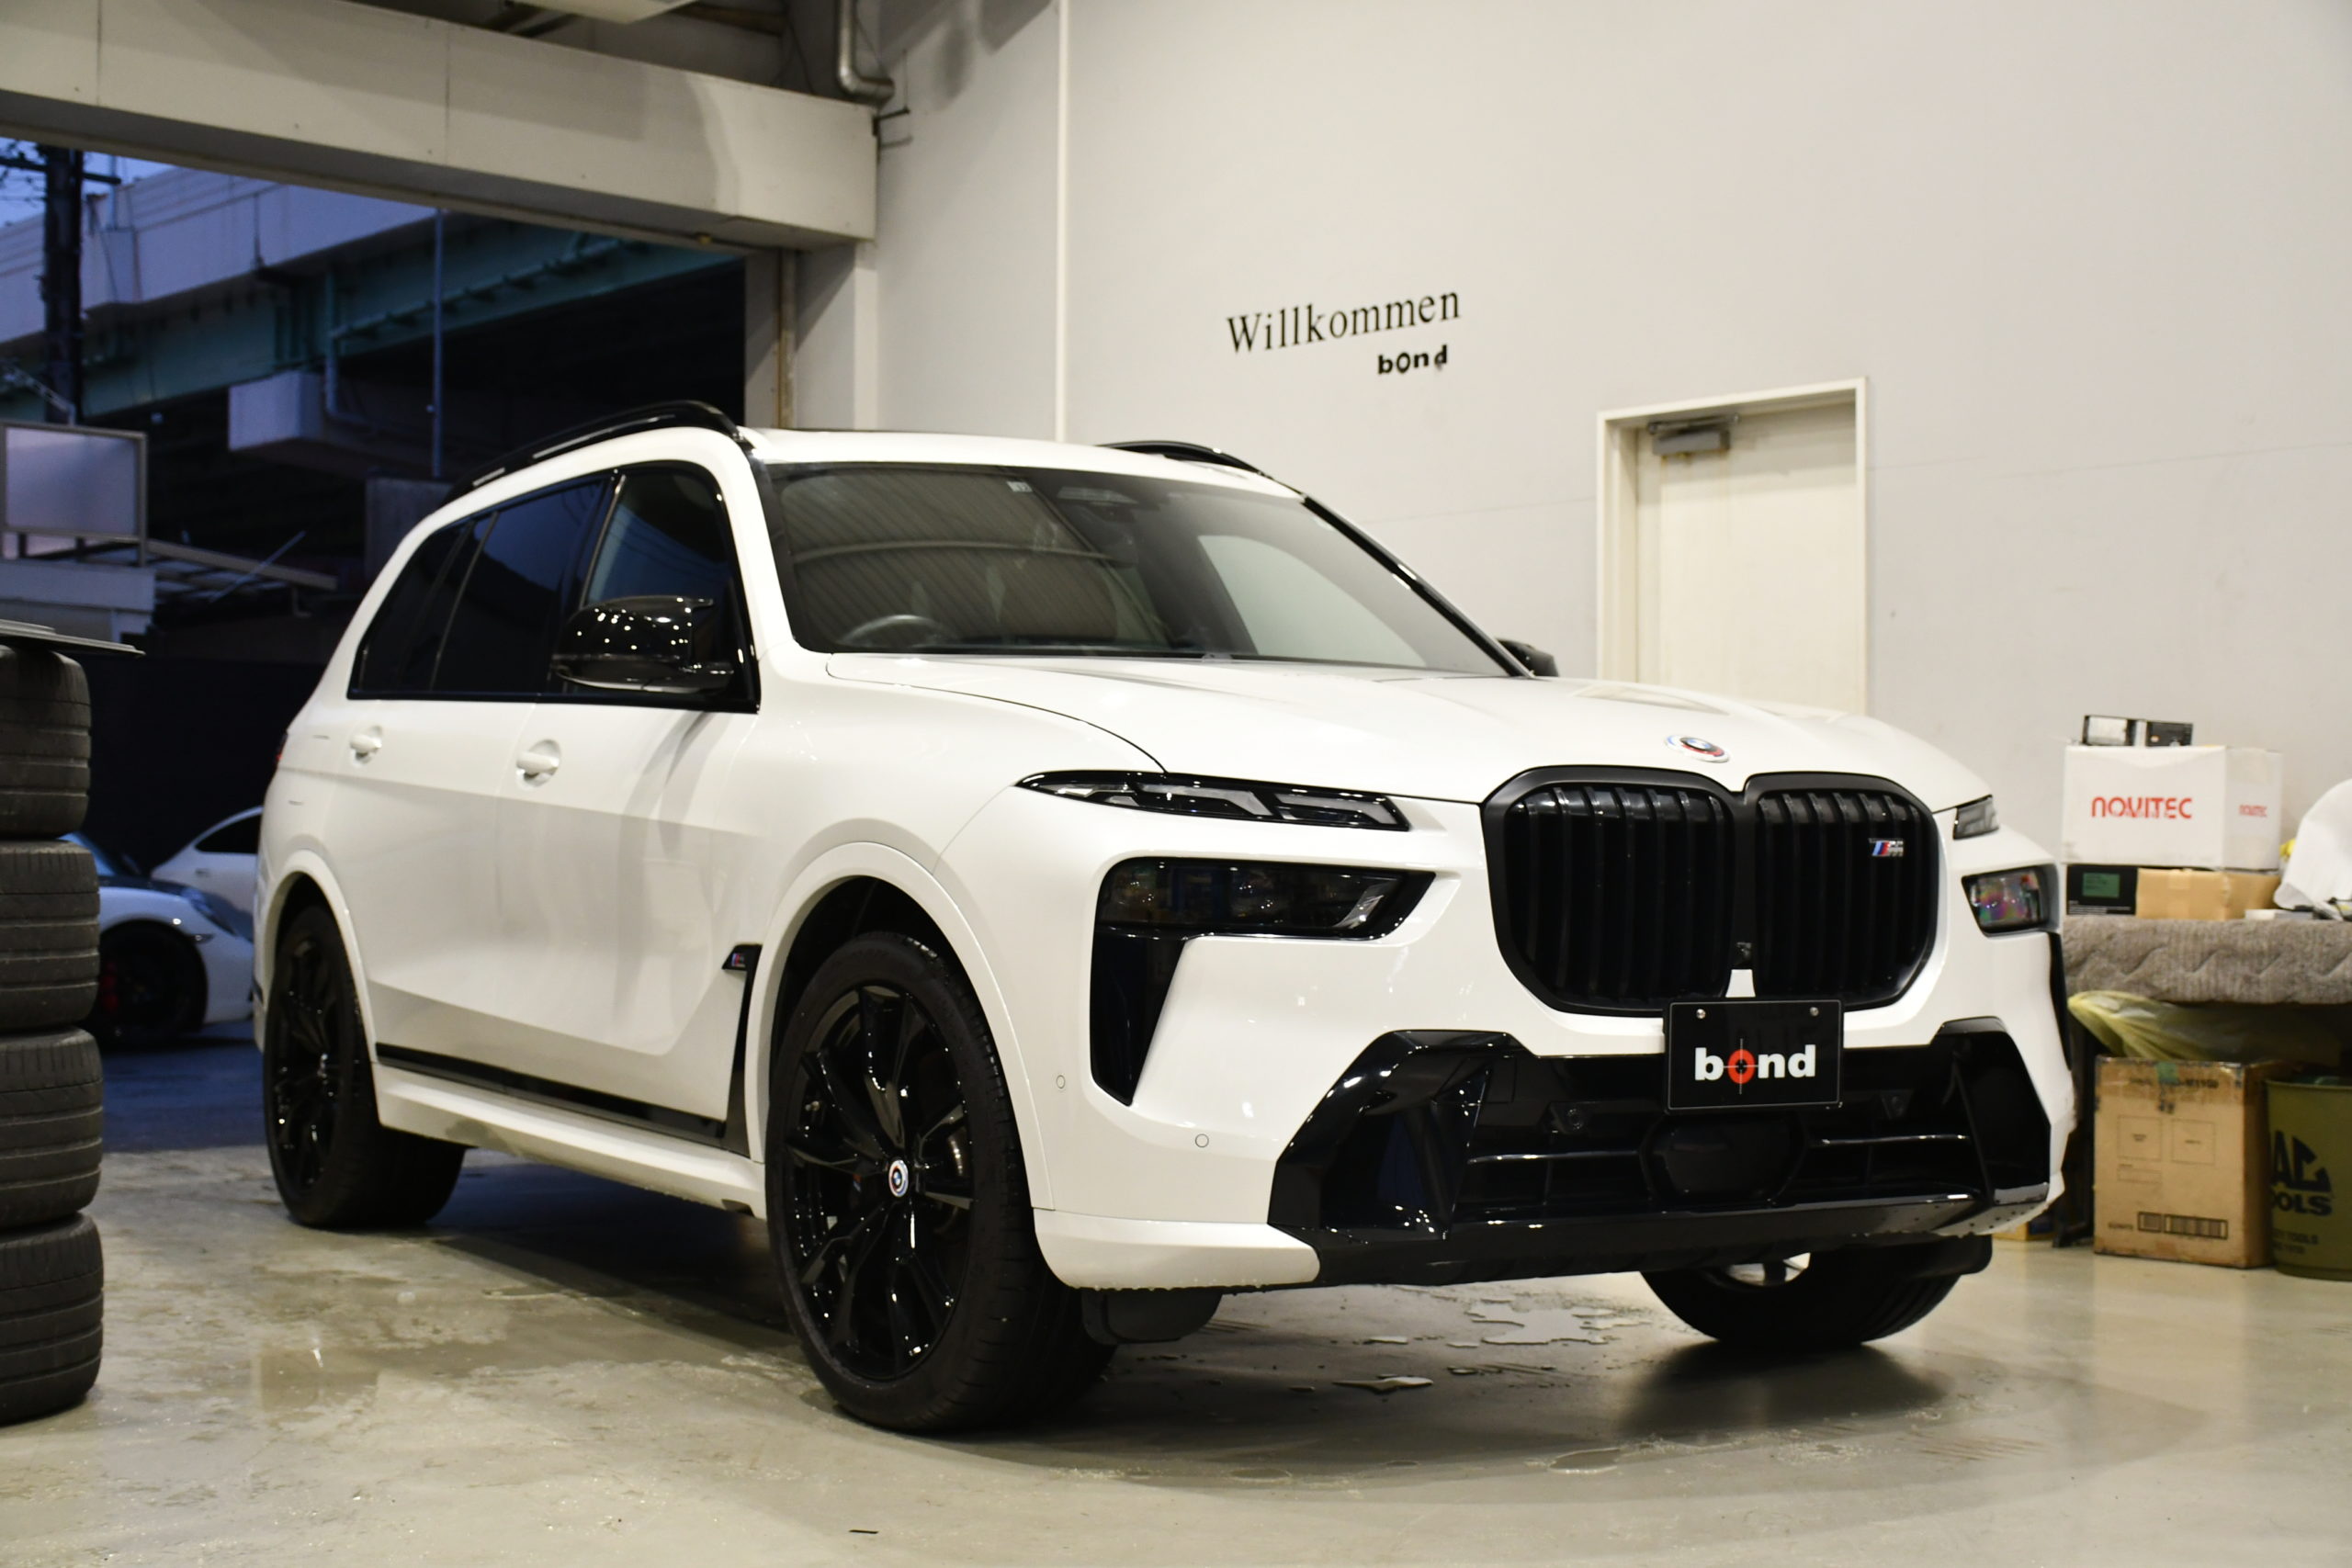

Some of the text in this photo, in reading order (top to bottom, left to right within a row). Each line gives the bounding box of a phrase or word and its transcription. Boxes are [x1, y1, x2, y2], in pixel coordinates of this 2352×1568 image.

[1226, 290, 1461, 354] Willkommen
[2091, 796, 2192, 818] NOVITEC
[1694, 1043, 1816, 1085] bond
[2270, 1130, 2333, 1192] AC
